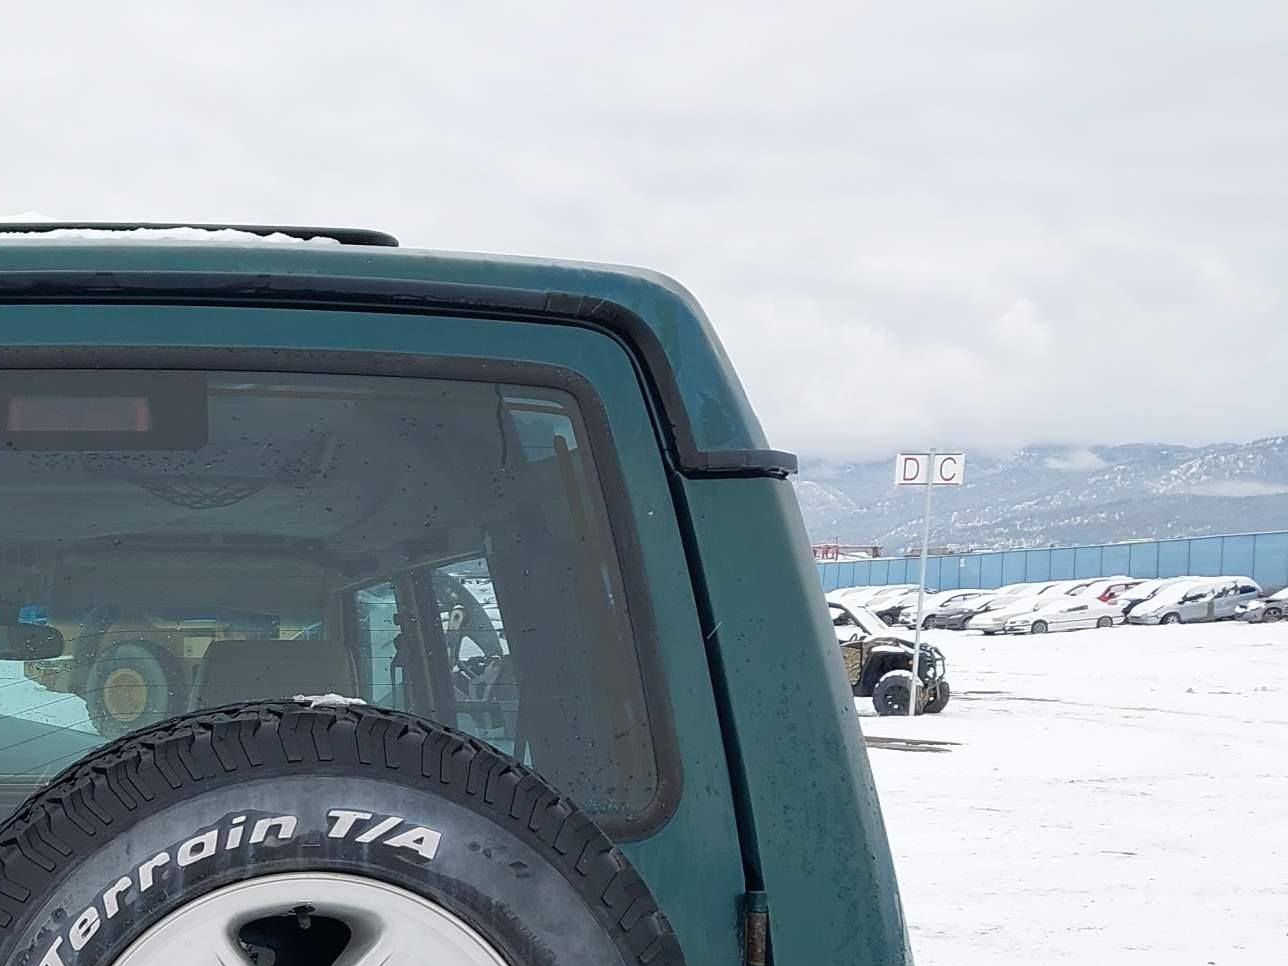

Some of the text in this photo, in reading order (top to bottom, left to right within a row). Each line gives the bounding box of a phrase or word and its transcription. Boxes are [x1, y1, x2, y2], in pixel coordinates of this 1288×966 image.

[903, 457, 920, 481] D
[939, 457, 957, 481] C
[327, 809, 442, 861] T/A
